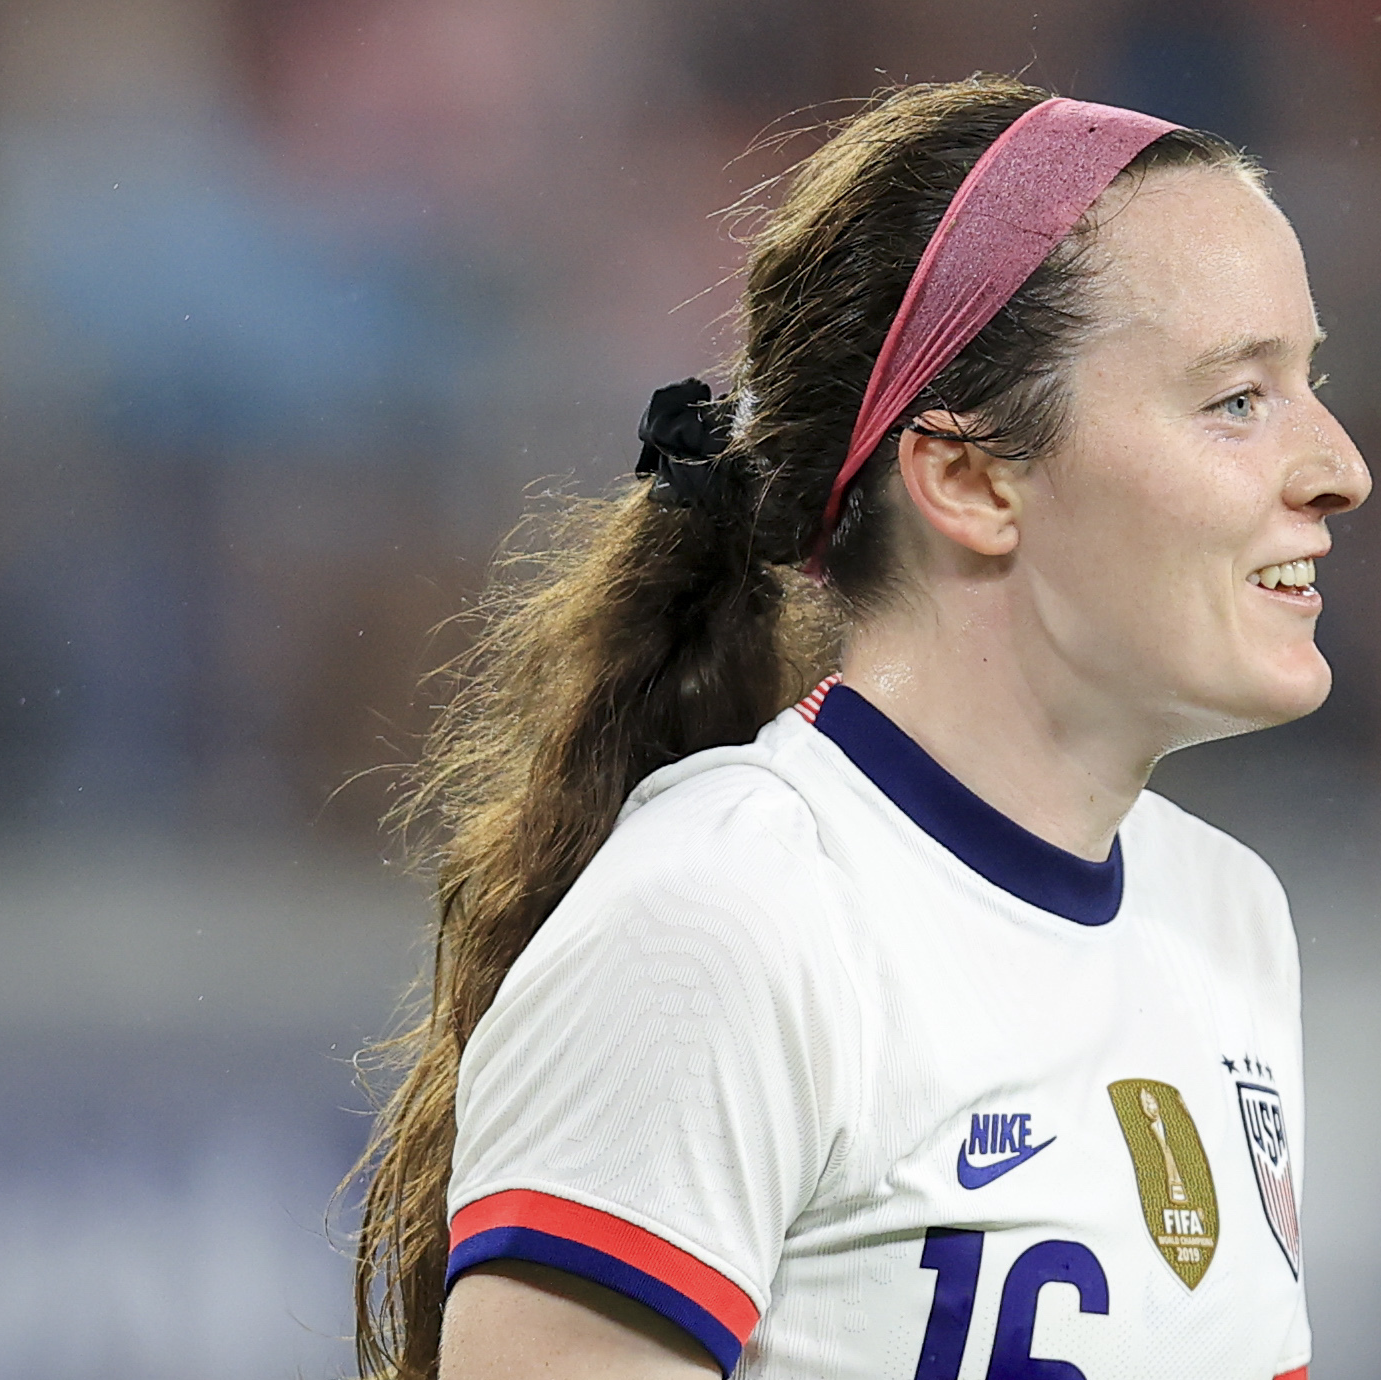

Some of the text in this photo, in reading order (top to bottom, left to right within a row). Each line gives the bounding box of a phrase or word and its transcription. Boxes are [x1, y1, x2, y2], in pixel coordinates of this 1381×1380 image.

[968, 1113, 1032, 1154] NIKE
[1244, 1098, 1287, 1168] USA
[1163, 1208, 1204, 1235] FIFA
[1176, 1247, 1201, 1264] 2019
